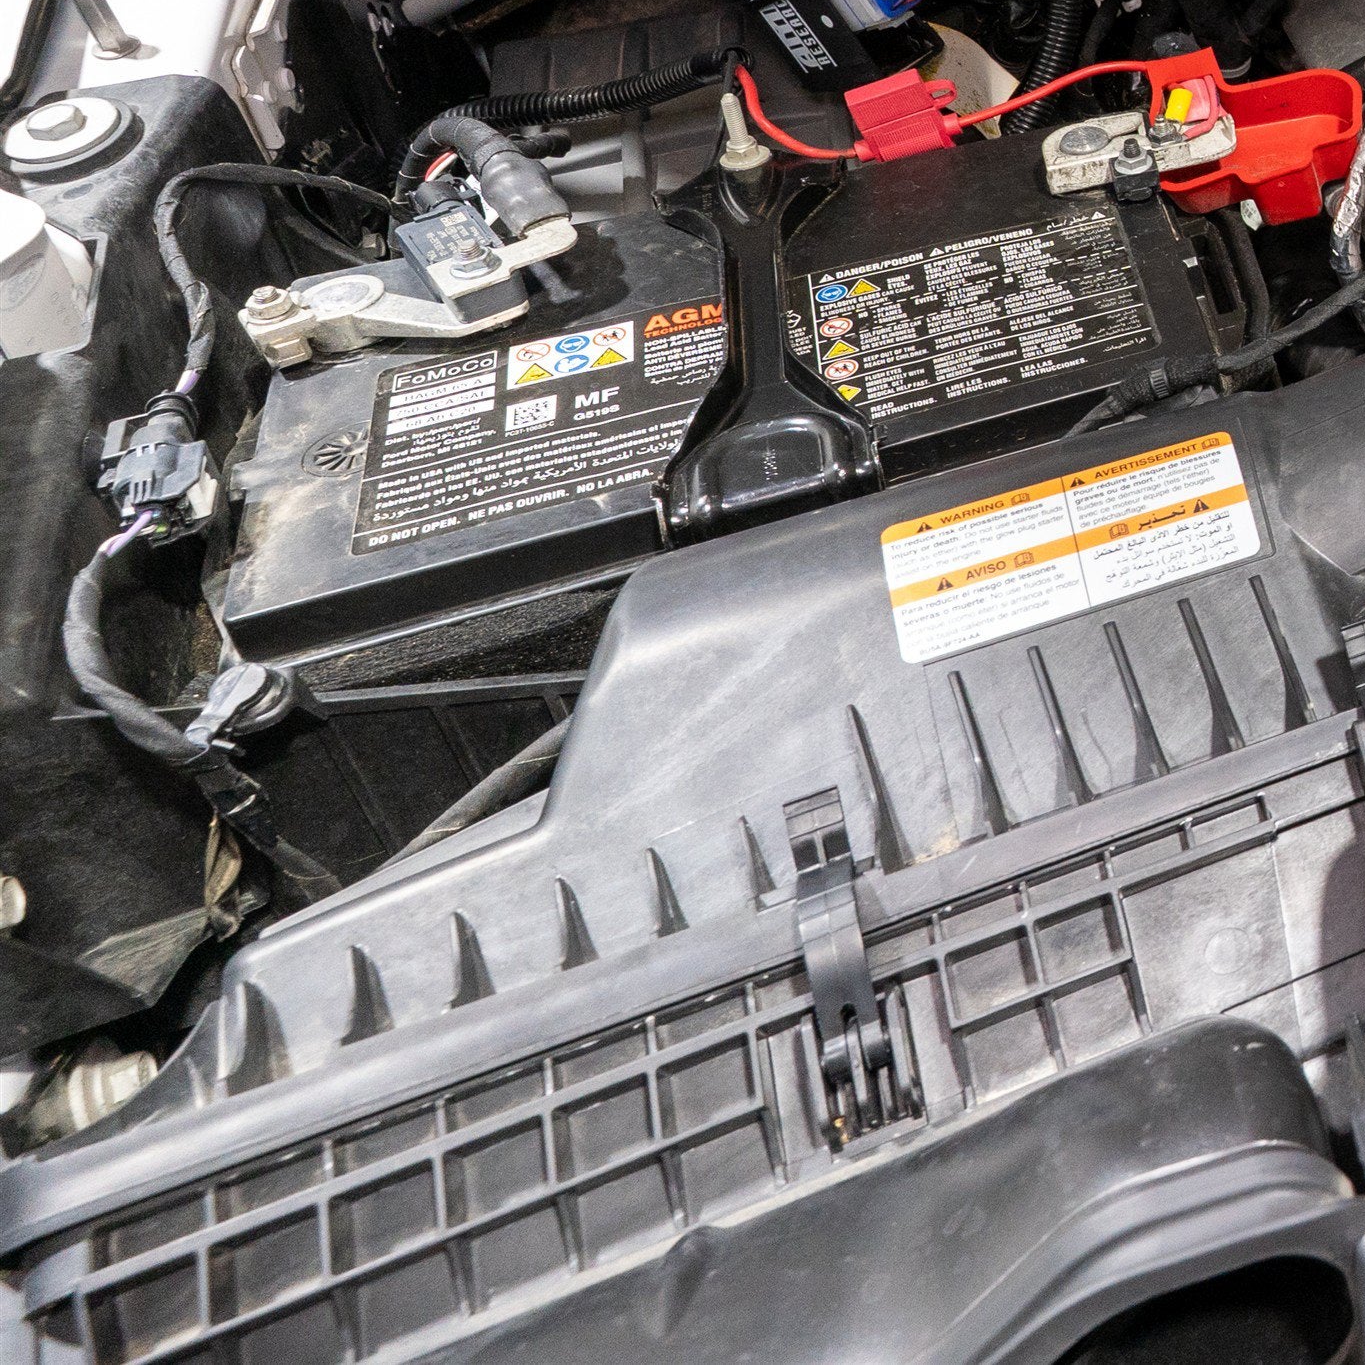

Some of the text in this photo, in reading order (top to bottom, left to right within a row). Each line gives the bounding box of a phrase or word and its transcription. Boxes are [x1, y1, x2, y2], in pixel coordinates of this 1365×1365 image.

[944, 226, 1032, 254] PELIGRO/VENENO
[835, 252, 923, 279] DANGER/POISON
[396, 355, 493, 388] FoMoCo
[1019, 359, 1052, 372] LEA LAS
[1021, 356, 1088, 379] INSTRUCCIONES.
[573, 385, 620, 409] MF
[945, 377, 982, 392] LIRE LES
[947, 376, 1010, 398] INSTRUCTIONS.
[870, 401, 894, 412] READ
[871, 396, 937, 419] INSTRUCTIONS.
[1073, 486, 1093, 496] Pour
[1096, 476, 1126, 489] réduire
[1138, 466, 1165, 478] risque
[1180, 449, 1221, 465] blessures
[1093, 443, 1197, 478] AVERTISSEMENT
[575, 466, 655, 493] NO LA ABRA.
[1075, 491, 1104, 504] graves
[1119, 483, 1131, 491] de
[1193, 461, 1208, 470] pas
[467, 487, 570, 520] NE PAS OUVRIR.
[940, 500, 1004, 525] WARNING
[368, 515, 461, 546] DO NOT OPEN.
[891, 543, 900, 551] To
[904, 533, 935, 547] reduce
[938, 527, 954, 537] risk
[969, 512, 1008, 529] possible
[1010, 502, 1043, 516] serious
[965, 560, 1006, 580] AVISO
